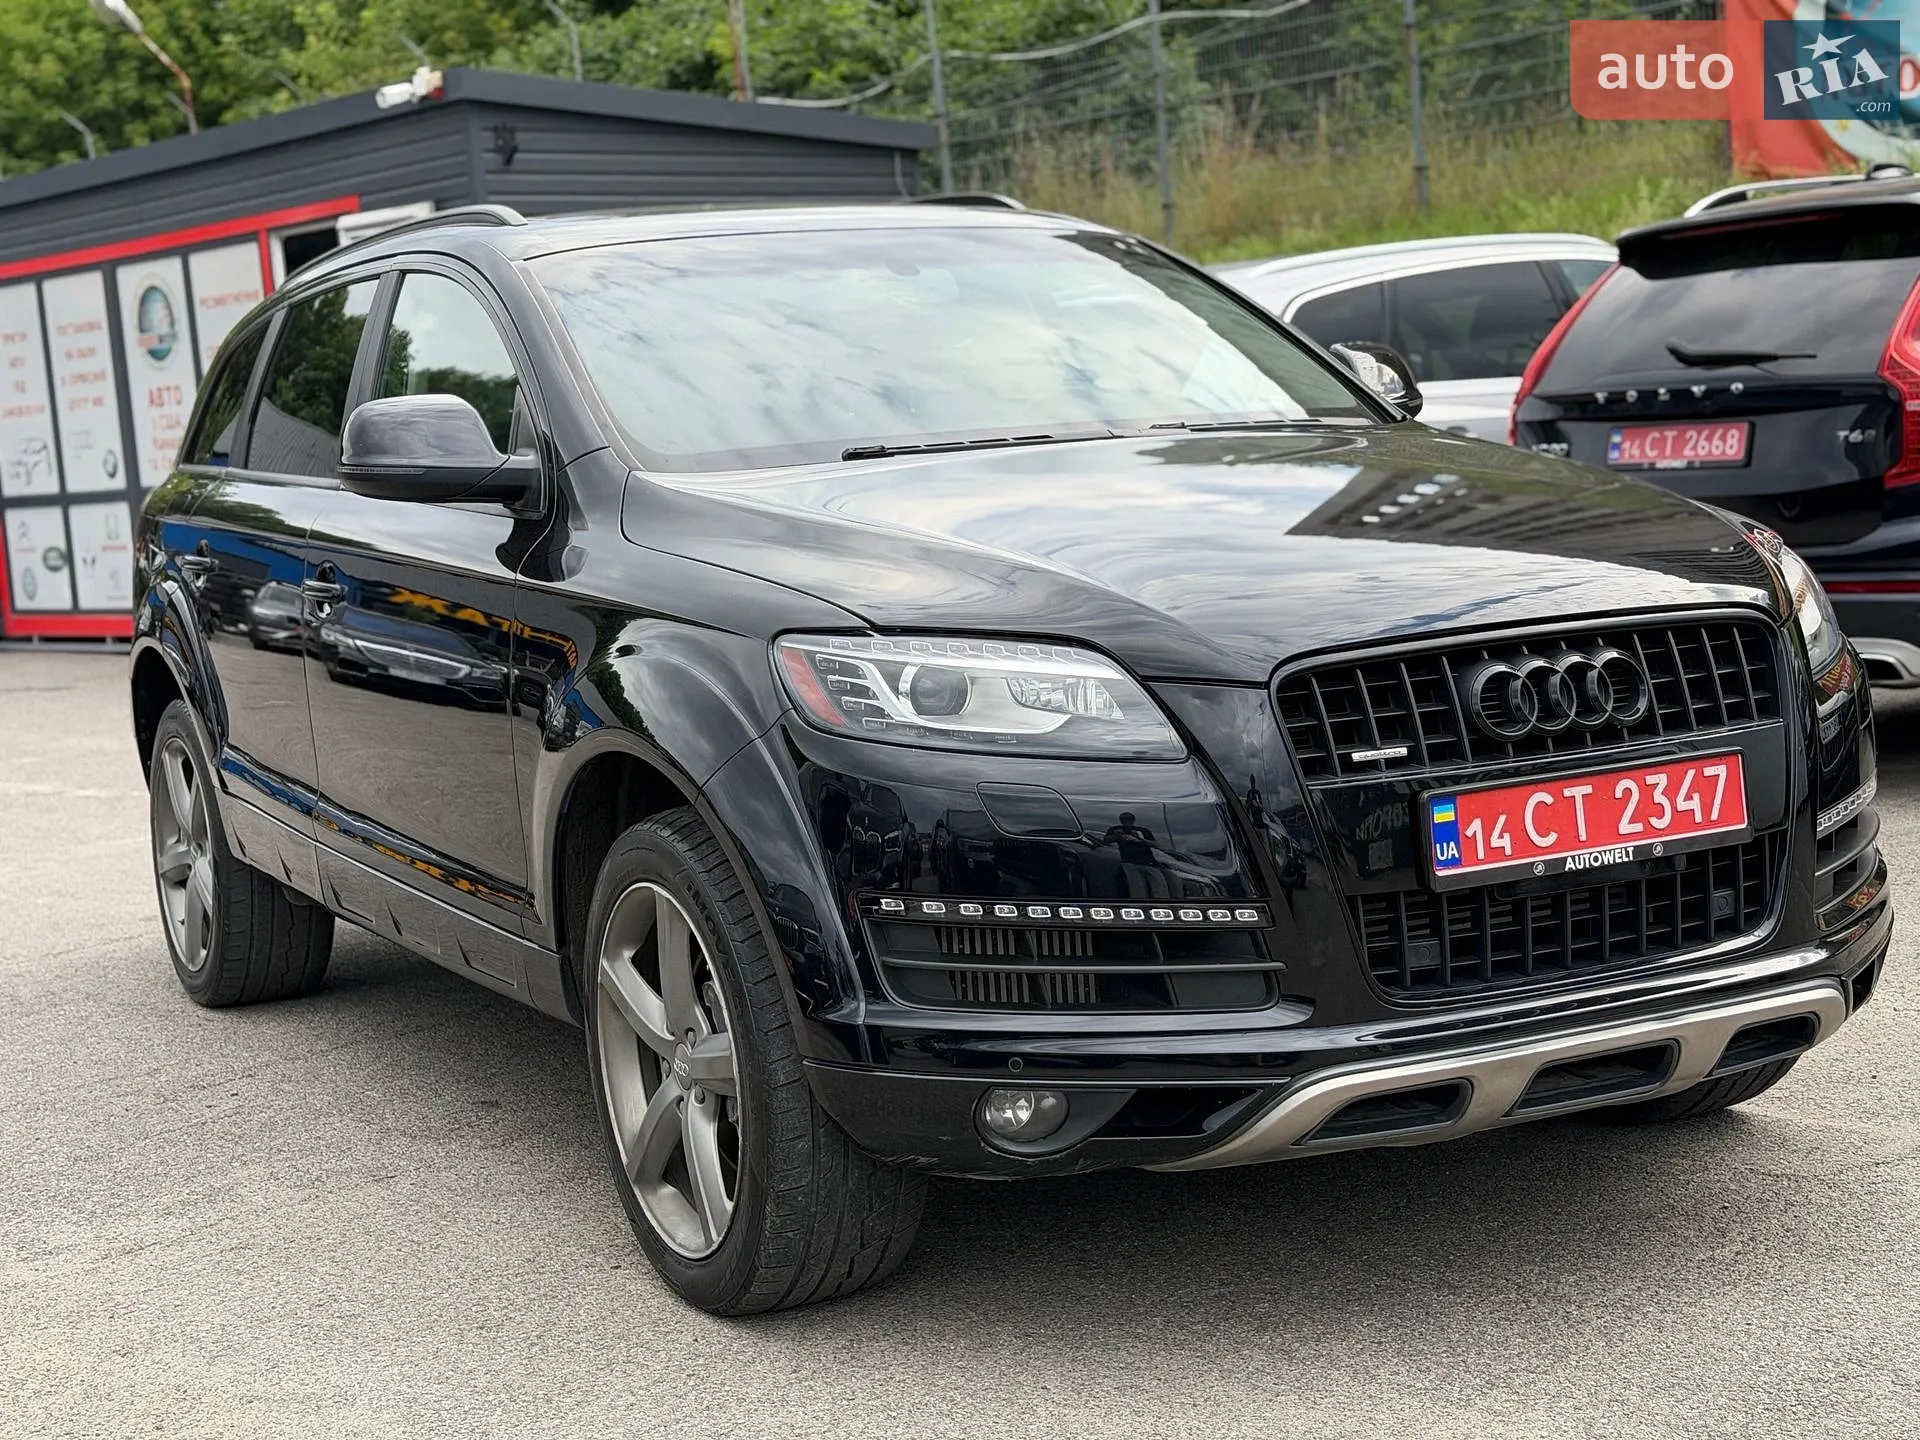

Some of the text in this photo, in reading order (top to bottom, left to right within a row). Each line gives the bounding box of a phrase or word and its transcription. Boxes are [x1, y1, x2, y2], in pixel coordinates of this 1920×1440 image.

[1594, 381, 1745, 405] VOLVO
[1682, 428, 1739, 457] 2668
[1614, 764, 1727, 836] 2347
[1436, 841, 1459, 861] UA
[1564, 846, 1635, 872] AUTOWELT
